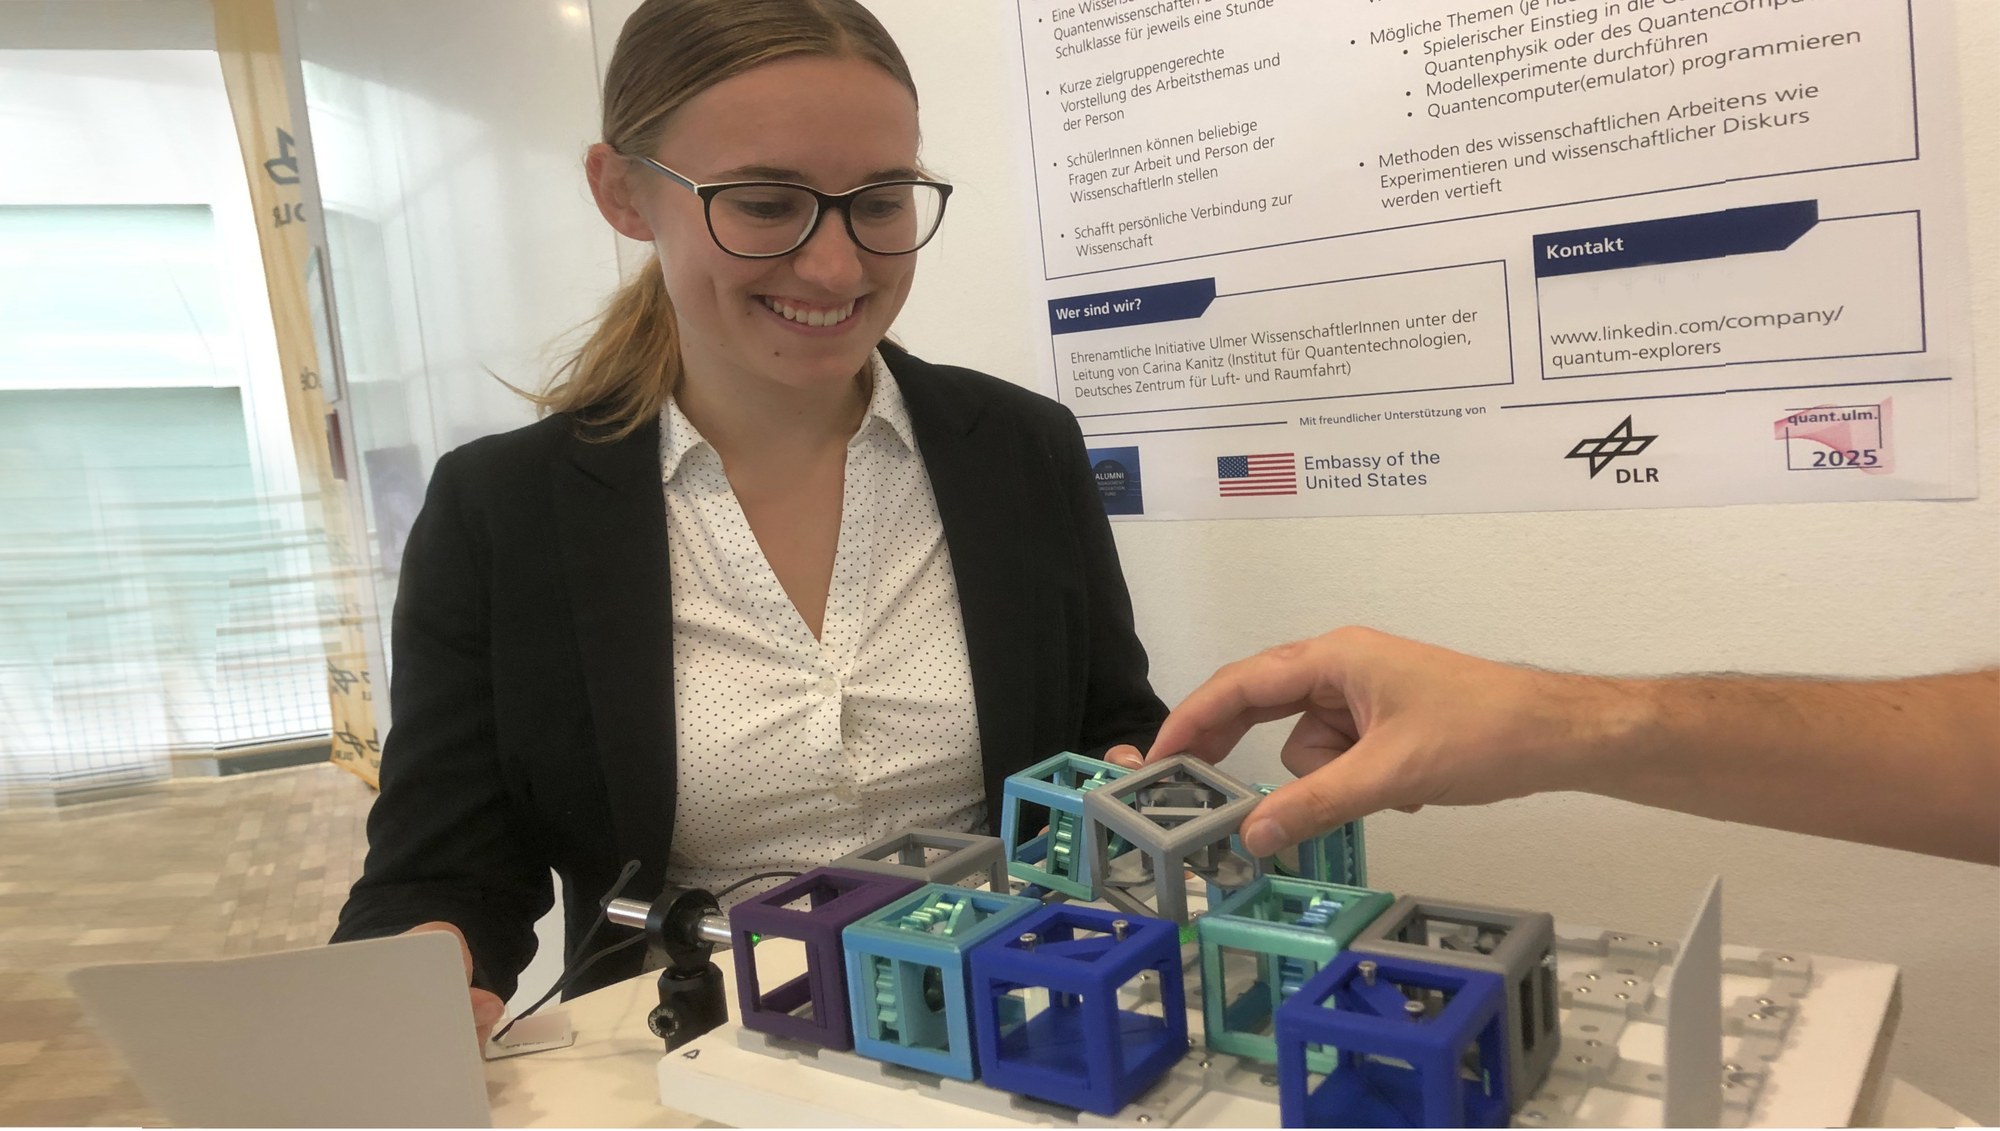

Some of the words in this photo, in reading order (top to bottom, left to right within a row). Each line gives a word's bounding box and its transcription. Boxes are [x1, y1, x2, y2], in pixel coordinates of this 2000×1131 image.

[1052, 8, 1076, 23] Eine
[1056, 34, 1122, 60] Schulklasse
[1125, 27, 1144, 42] für
[1147, 15, 1191, 41] jeweils
[1194, 10, 1222, 25] eine
[1226, 0, 1275, 18] Stunde
[1370, 20, 1442, 46] Mögliche
[1447, 5, 1514, 29] Themen
[1424, 24, 1525, 57] Spielerischer
[1531, 9, 1598, 33] Einstieg
[1605, 2, 1621, 18] in
[1425, 38, 1549, 77] Quantenphysik
[1554, 31, 1596, 51] oder
[1601, 24, 1632, 41] des
[1427, 56, 1588, 97] Modellexperimente
[1594, 33, 1708, 65] durchführen
[1060, 79, 1093, 96] Kurze
[1096, 49, 1225, 87] zielgruppengerechte
[1061, 90, 1127, 114] Vorstellung
[1131, 84, 1153, 98] des
[1156, 63, 1250, 93] Arbeitsthemas
[1254, 52, 1281, 71] und
[1428, 58, 1675, 119] Quantencomputer(emulator)
[1682, 32, 1861, 76] programmieren
[1063, 118, 1082, 132] der
[1085, 110, 1125, 127] Person
[1379, 144, 1460, 169] Methoden
[1466, 138, 1494, 154] des
[1498, 112, 1661, 149] wissenschaftlichen
[1667, 93, 1768, 121] Arbeitens
[1775, 83, 1820, 103] wie
[1067, 144, 1143, 168] SchülerInnen
[1146, 134, 1194, 152] können
[1198, 121, 1258, 142] beliebige
[1069, 170, 1108, 186] Fragen
[1111, 165, 1131, 178] zur
[1134, 155, 1173, 174] Arbeit
[1176, 148, 1201, 166] und
[1205, 143, 1249, 160] Person
[1253, 136, 1276, 151] der
[1381, 159, 1508, 190] Experimentieren
[1514, 148, 1547, 168] und
[1552, 125, 1717, 162] wissenschaftlicher
[1724, 111, 1810, 135] Diskurs
[1070, 175, 1174, 204] WissenschaftlerIn
[1178, 168, 1219, 185] stellen
[1381, 189, 1440, 209] werden
[1445, 178, 1503, 200] vertieft
[1075, 221, 1116, 240] Schafft
[1119, 211, 1188, 236] persönliche
[1191, 199, 1267, 220] Verbindung
[1271, 194, 1293, 207] zur
[1076, 233, 1154, 257] Wissenschaft
[1546, 237, 1625, 260] Kontakt
[1056, 308, 1081, 321] Wer
[1084, 302, 1111, 318] sind
[1113, 298, 1142, 313] wir?
[1551, 305, 1845, 346] www.linkedin.com/company/
[1071, 345, 1152, 365] Ehrenamtliche
[1155, 341, 1206, 356] Initiative
[1210, 336, 1248, 350] Ulmer
[1251, 320, 1400, 345] WissenschaftlerInnen
[1406, 315, 1447, 329] unter
[1452, 309, 1478, 325] der
[1553, 342, 1722, 370] quantum-explorers
[1073, 369, 1115, 382] Leitung
[1118, 366, 1140, 377] von
[1143, 362, 1182, 375] Carina
[1186, 356, 1225, 371] Kanitz
[1228, 351, 1278, 369] (Institut
[1281, 348, 1301, 361] für
[1305, 332, 1472, 361] Quantentechnologien,
[1075, 383, 1133, 399] Deutsches
[1135, 380, 1186, 393] Zentrum
[1189, 375, 1207, 389] für
[1211, 372, 1241, 387] Luft-
[1245, 368, 1270, 384] und
[1275, 361, 1352, 381] Raumfahrt)
[1300, 417, 1317, 427] Mit
[1319, 413, 1382, 425] freundlicher
[1385, 408, 1463, 421] Unterstützung
[1465, 407, 1487, 416] von
[1788, 409, 1878, 426] quant.ulm.
[1095, 472, 1125, 480] ALUMNI
[1304, 455, 1382, 471] Embassy
[1387, 451, 1405, 467] of
[1410, 450, 1441, 466] the
[1616, 468, 1660, 485] DLR
[1812, 449, 1878, 467] 2025
[1306, 473, 1362, 490] United
[1367, 473, 1428, 488] States
